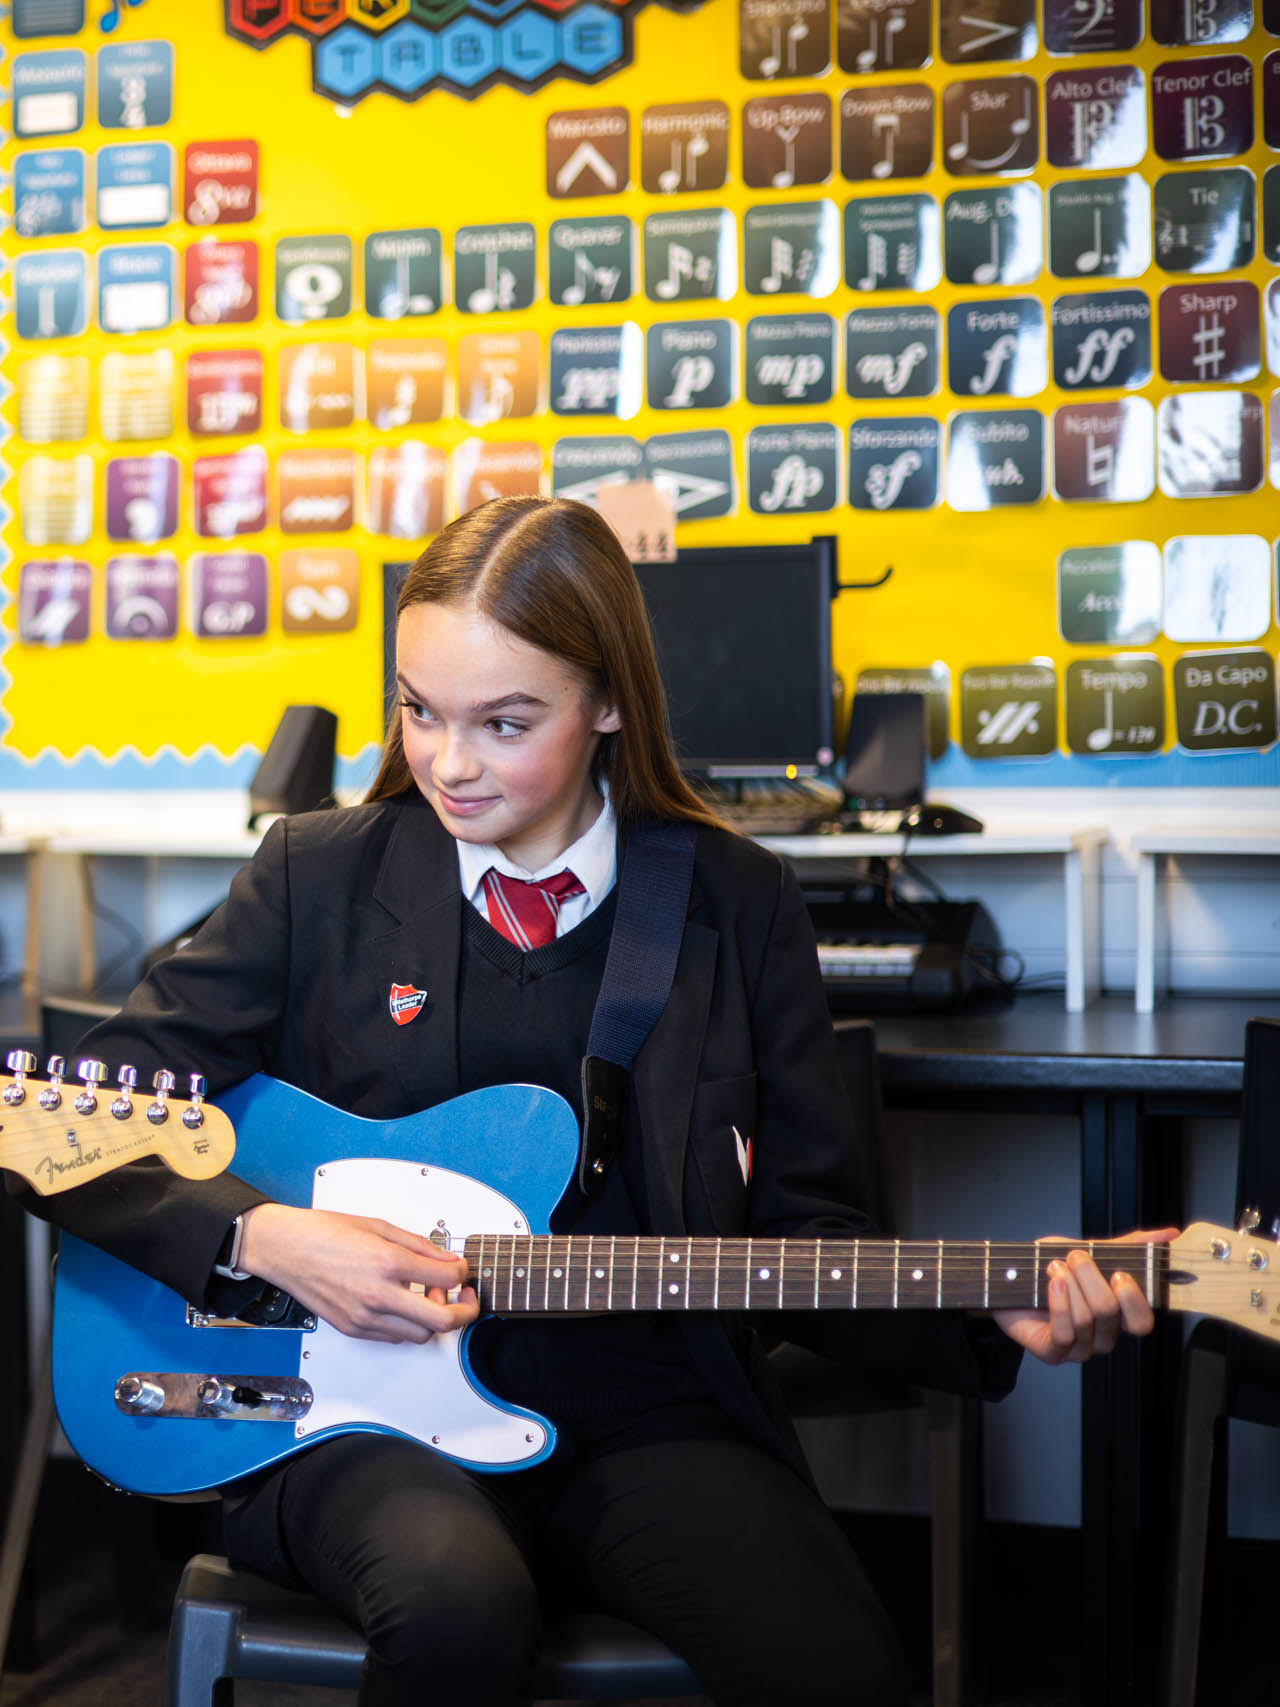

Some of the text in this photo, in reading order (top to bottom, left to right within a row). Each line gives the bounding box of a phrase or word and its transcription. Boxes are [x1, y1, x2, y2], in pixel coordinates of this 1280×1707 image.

[332, 23, 606, 75] TABLE
[1051, 81, 1093, 100] Alto
[1153, 75, 1208, 93] Tenor
[1213, 68, 1252, 87] Clef
[970, 90, 1008, 110] Slur
[1189, 188, 1219, 205] Tie
[1179, 294, 1238, 314] Sharp
[967, 311, 1020, 331] Forte
[1052, 304, 1150, 326] Fortissimo
[1064, 414, 1122, 433] Natur
[1080, 669, 1148, 693] Tempo
[1185, 666, 1268, 687] Da Capo
[1192, 699, 1263, 736] D.C.
[34, 1142, 103, 1185] Fender
